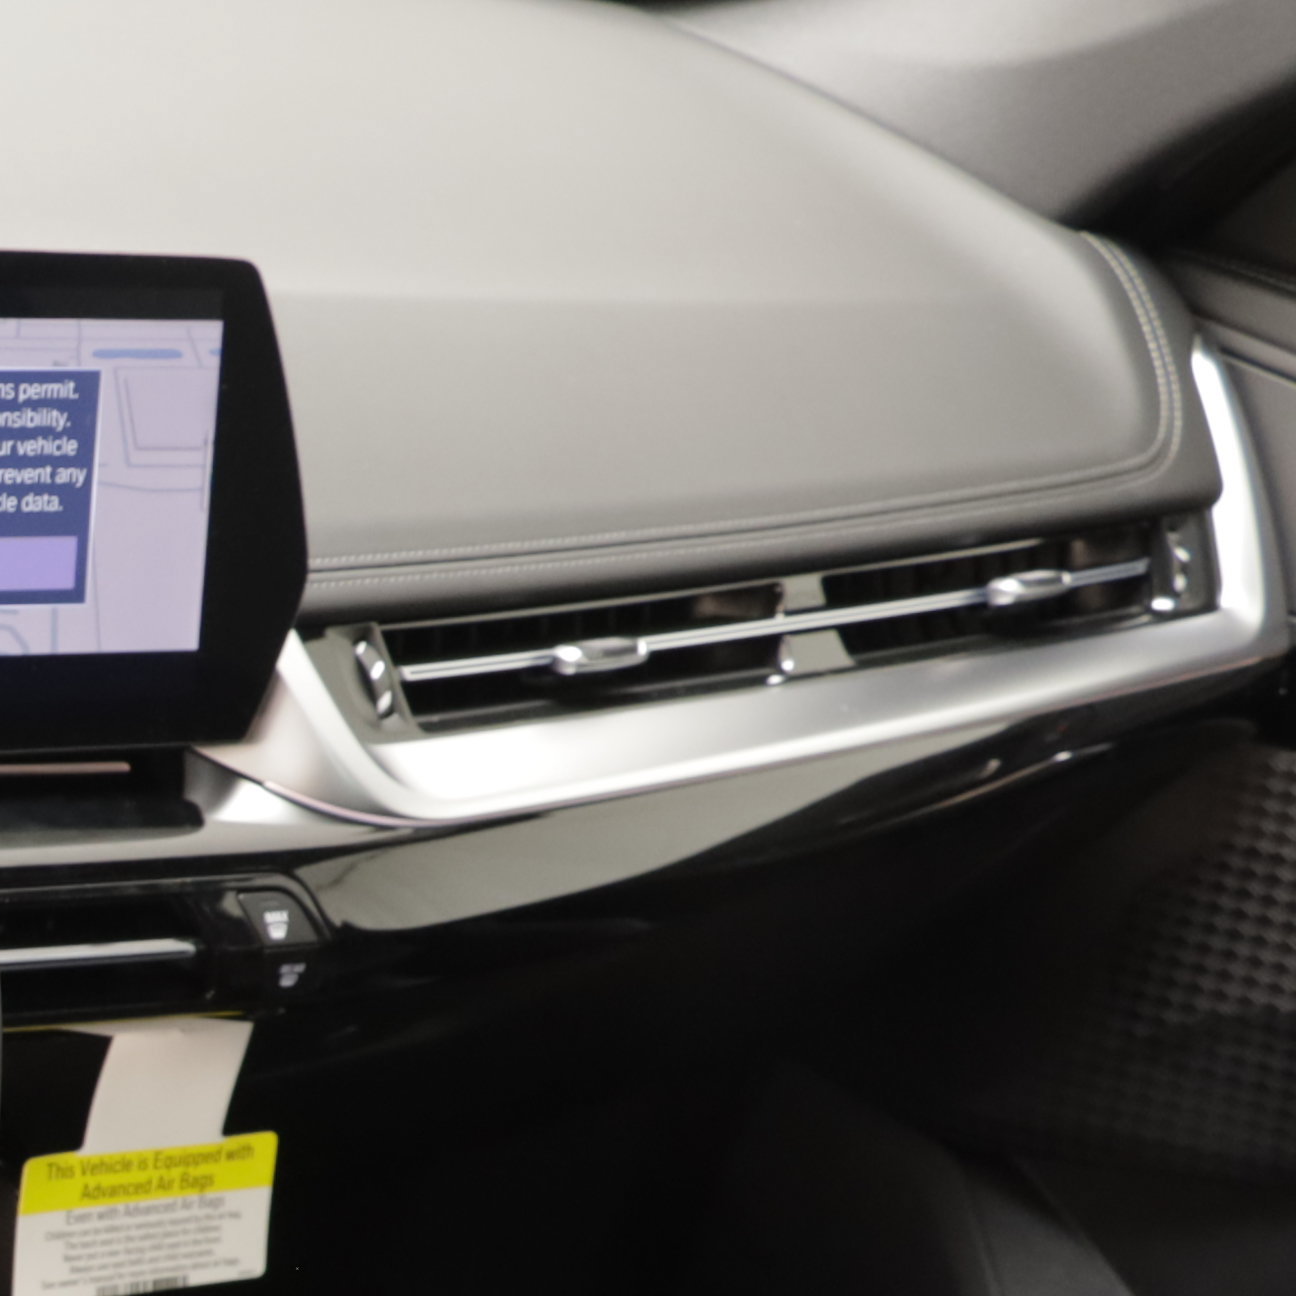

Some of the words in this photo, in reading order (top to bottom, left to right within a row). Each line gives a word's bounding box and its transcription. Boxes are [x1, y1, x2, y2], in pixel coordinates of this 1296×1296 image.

[17, 378, 79, 403] permit.
[16, 436, 78, 457] vehicle
[54, 466, 87, 488] any
[21, 492, 63, 513] data.
[45, 1162, 75, 1182] This
[79, 1156, 133, 1178] Vehicle
[137, 1157, 151, 1173] is
[153, 1146, 223, 1173] Equipped
[224, 1142, 255, 1162] with
[78, 1179, 153, 1201] Advanced
[156, 1177, 177, 1193] Air
[179, 1172, 216, 1192] Bags
